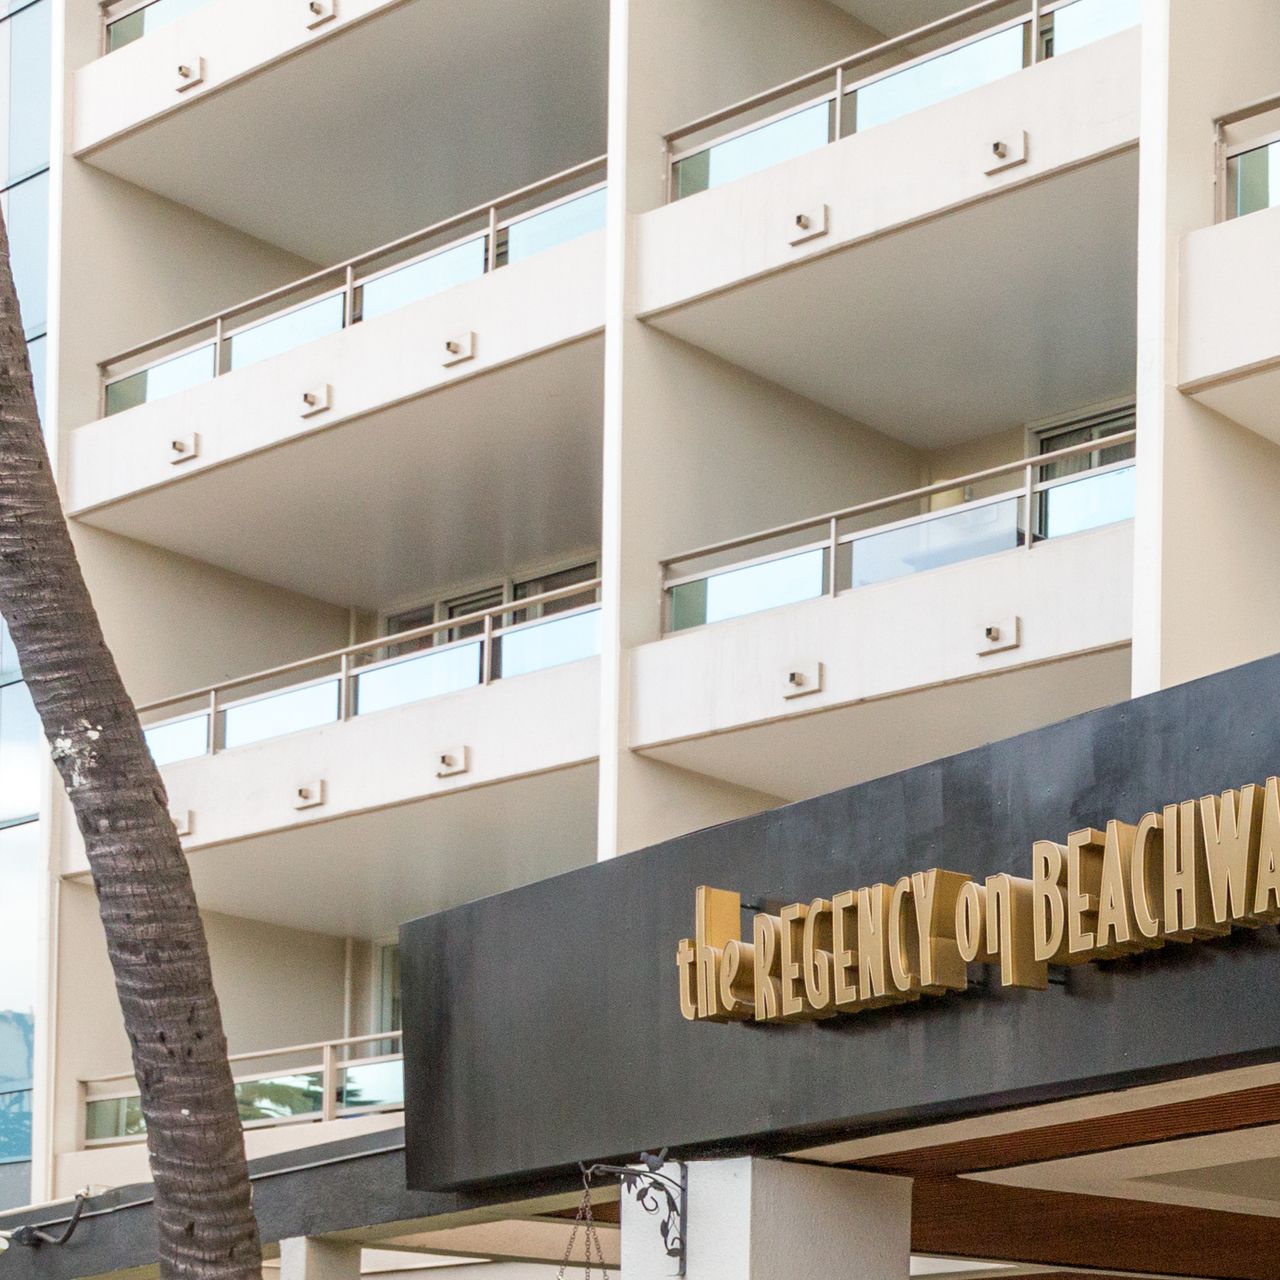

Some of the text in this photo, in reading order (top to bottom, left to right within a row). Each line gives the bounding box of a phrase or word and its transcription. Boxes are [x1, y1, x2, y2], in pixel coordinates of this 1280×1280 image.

[676, 885, 746, 1021] the
[752, 868, 950, 1021] REGENCY
[955, 871, 1030, 989] on
